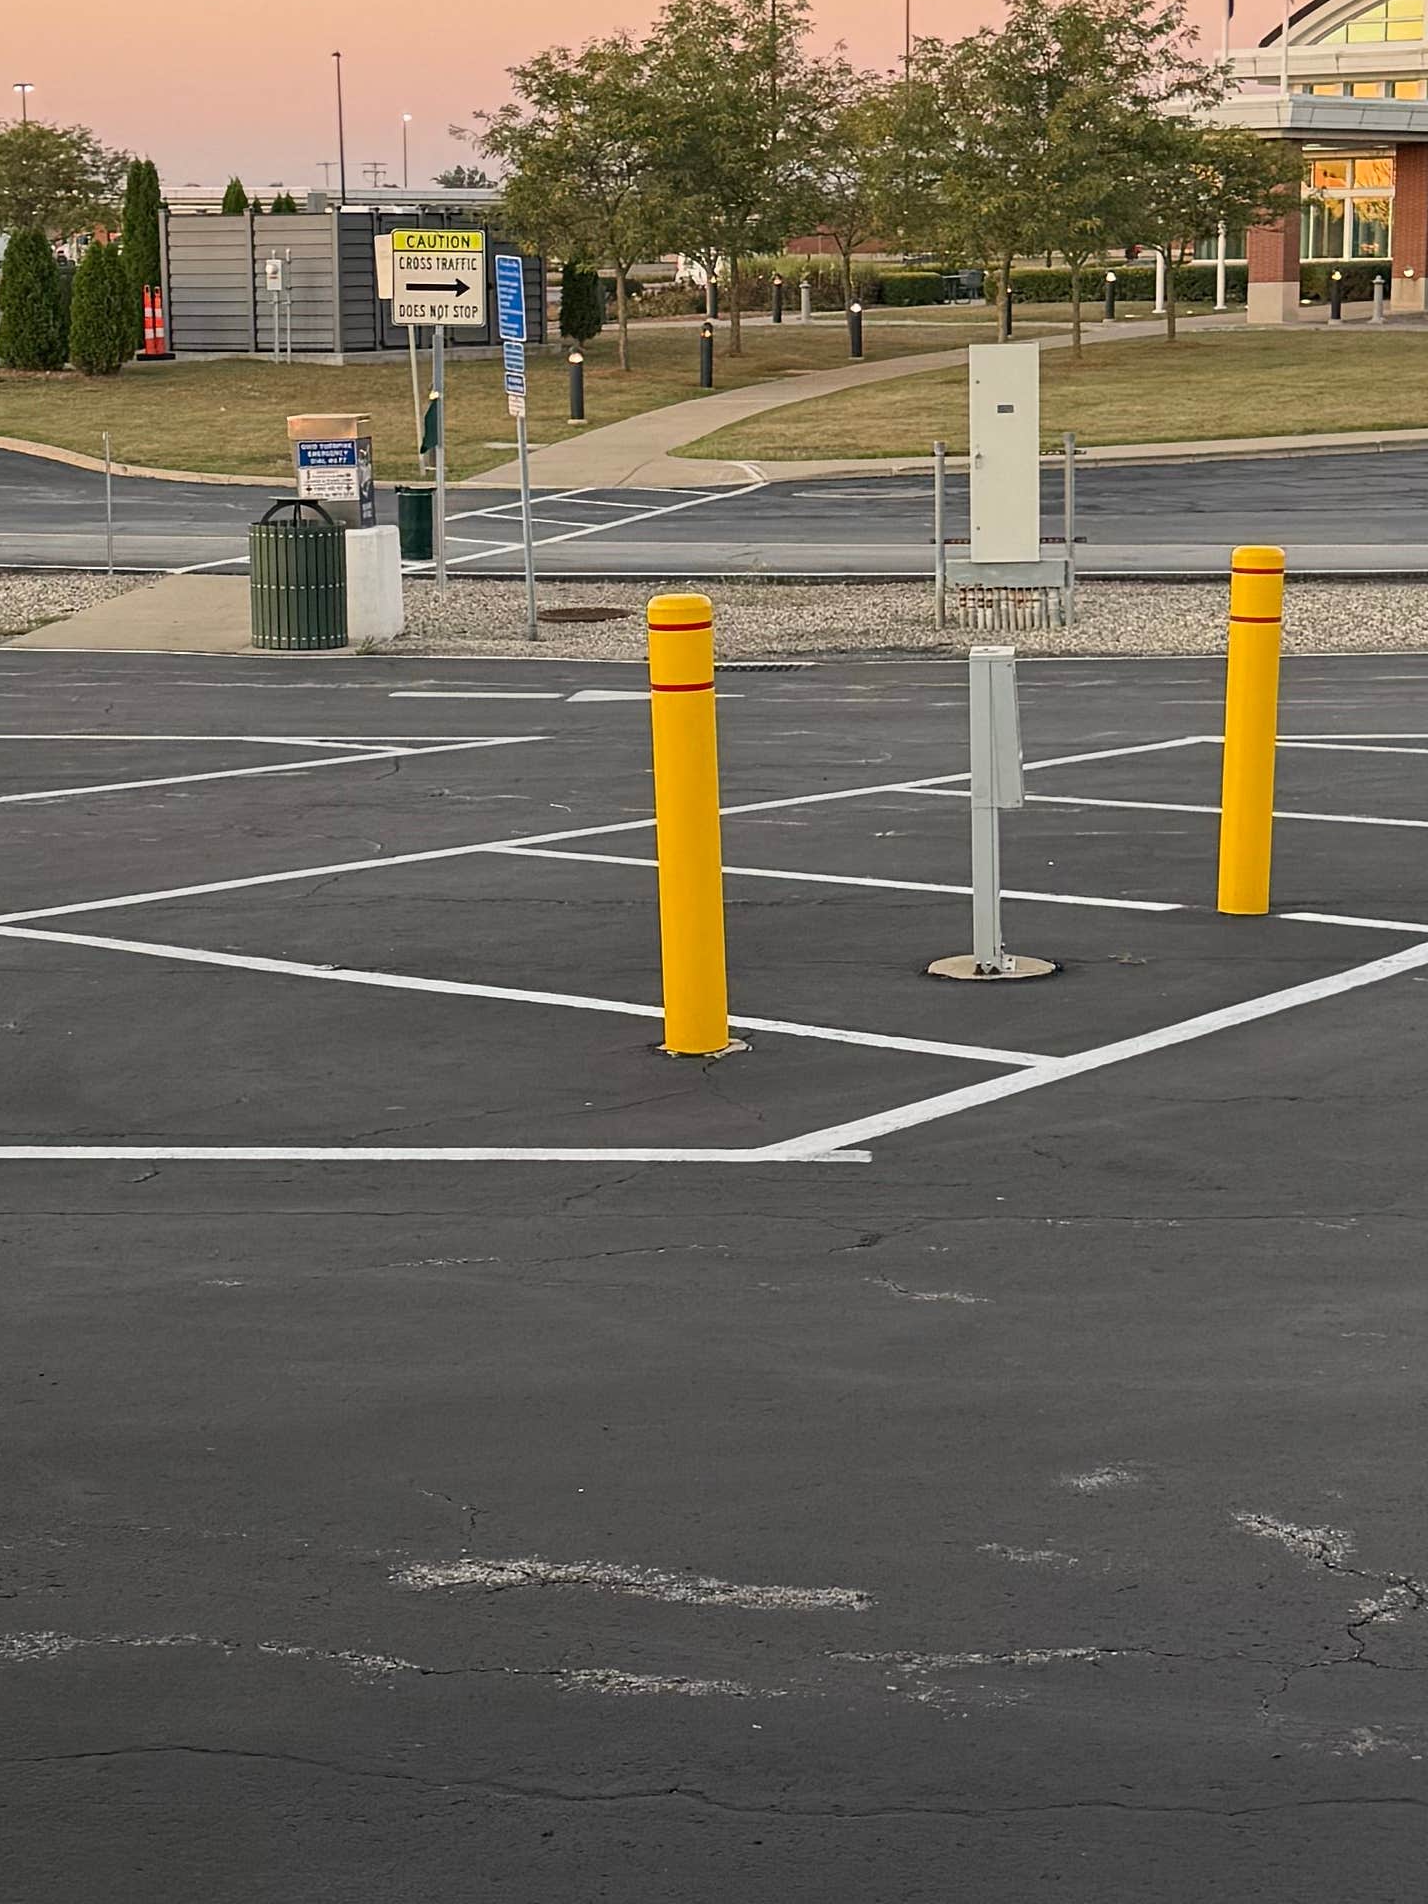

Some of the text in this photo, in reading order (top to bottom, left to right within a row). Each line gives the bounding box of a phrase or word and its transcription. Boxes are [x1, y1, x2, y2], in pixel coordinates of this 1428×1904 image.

[406, 235, 471, 248] CAUTION
[399, 257, 477, 270] CROSS TRAFFIC
[399, 305, 479, 318] DOES NOT STOP
